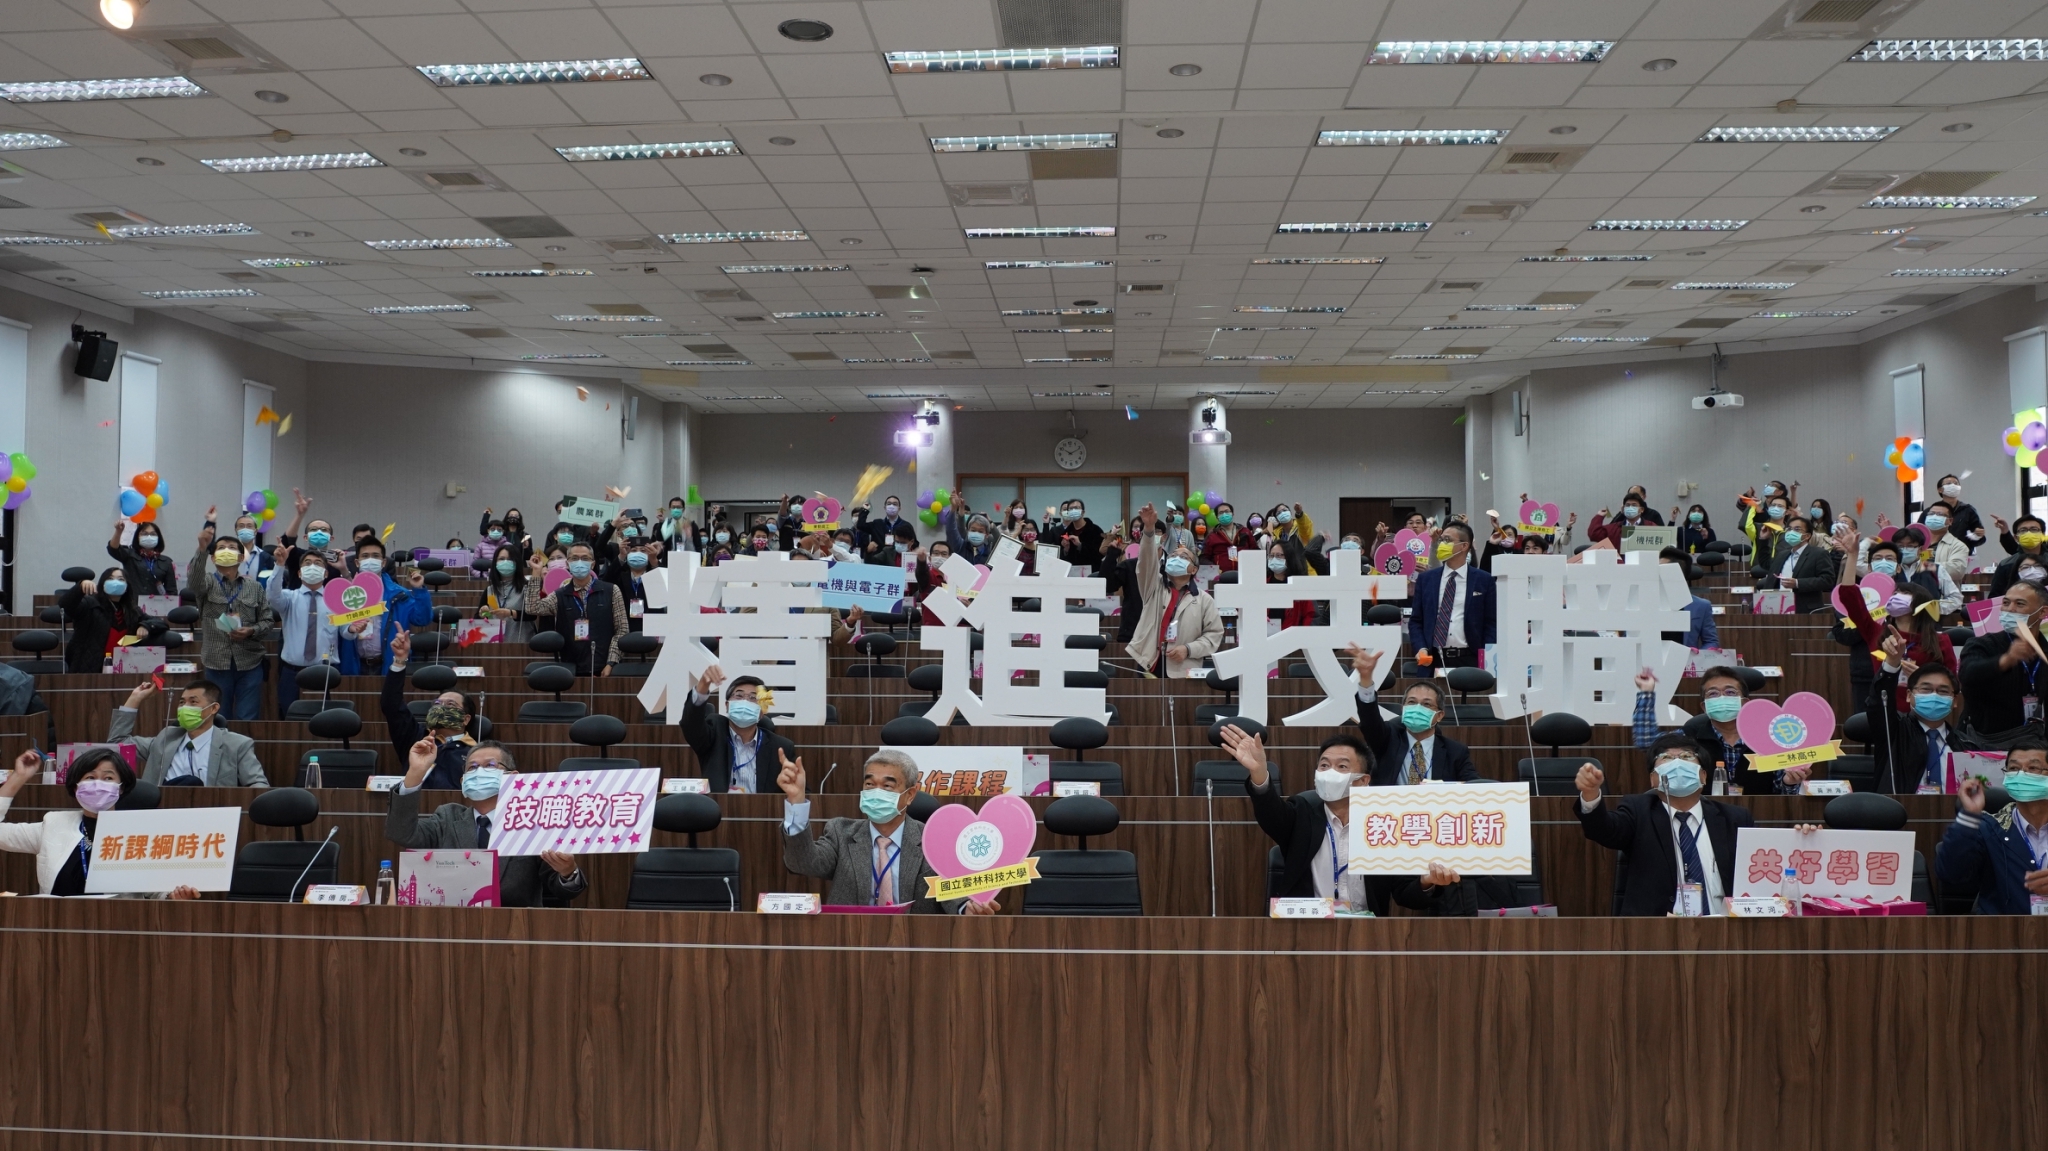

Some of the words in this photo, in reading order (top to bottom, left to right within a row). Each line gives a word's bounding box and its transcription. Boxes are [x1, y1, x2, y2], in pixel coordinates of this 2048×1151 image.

[575, 507, 604, 518] 農業群
[1636, 535, 1664, 546] 機械群
[345, 610, 371, 620] 竹崎高中
[637, 549, 1694, 726] 精進技職
[1777, 750, 1817, 764] 二林高中
[504, 792, 644, 831] 技職教育
[1366, 812, 1505, 846] 教學創新
[99, 833, 227, 861] 新課綱時代
[1749, 848, 1900, 885] 共好學習
[940, 867, 1028, 892] 國立雲林科技大學
[771, 902, 804, 911] 方國定
